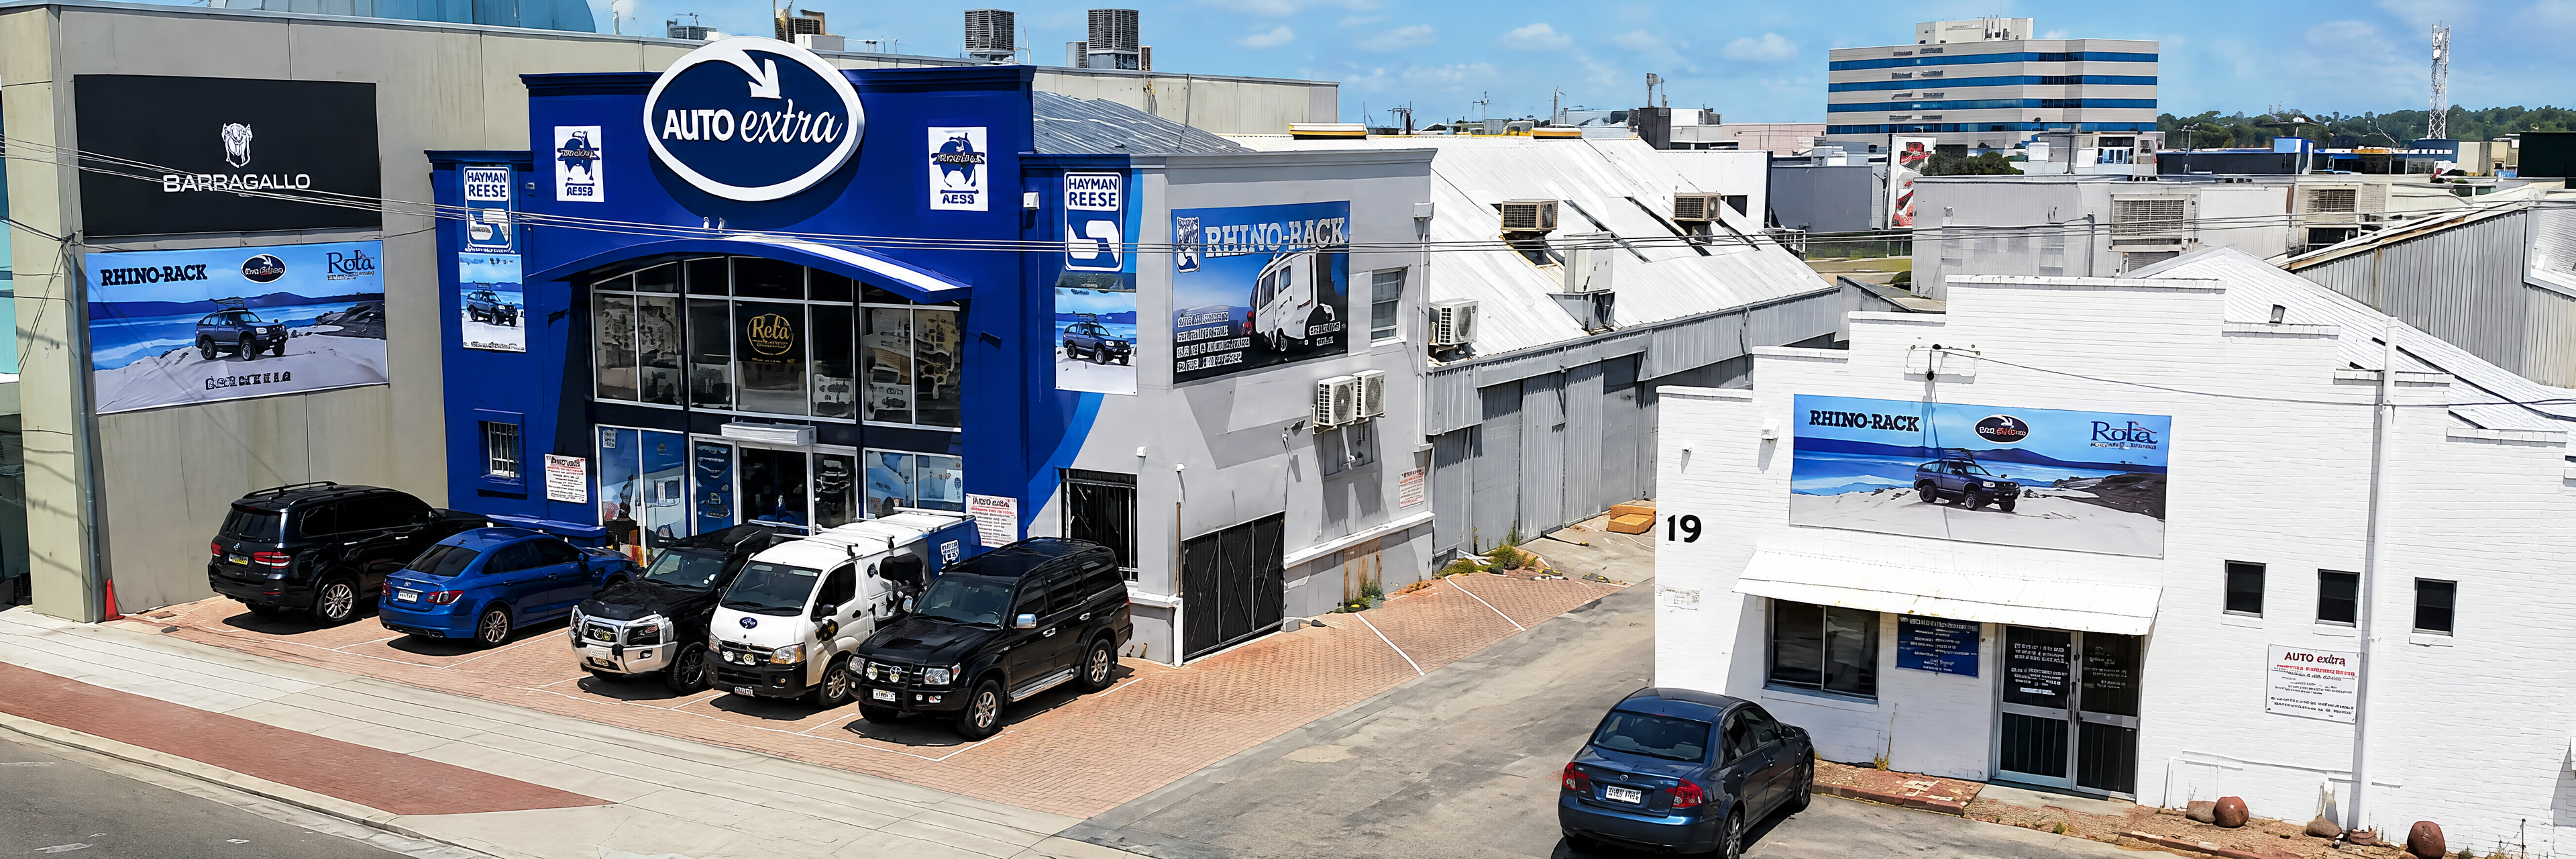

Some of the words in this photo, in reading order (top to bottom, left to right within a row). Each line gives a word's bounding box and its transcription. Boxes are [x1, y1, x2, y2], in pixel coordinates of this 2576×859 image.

[662, 109, 735, 142] AUTO
[740, 98, 843, 144] extra
[162, 173, 311, 193] BARRAGALLO
[467, 172, 506, 183] HAYMAN
[1069, 178, 1118, 191] HAYMAN
[468, 184, 506, 198] REESE
[1069, 191, 1117, 207] REESE
[1205, 217, 1346, 258] RHINO-RACK
[100, 264, 208, 287] RHINO-RACK
[1809, 409, 1920, 432] RHINO-RACK
[1667, 514, 1702, 544] 19
[2284, 652, 2314, 662] AUTO
[2317, 654, 2346, 666] extra
